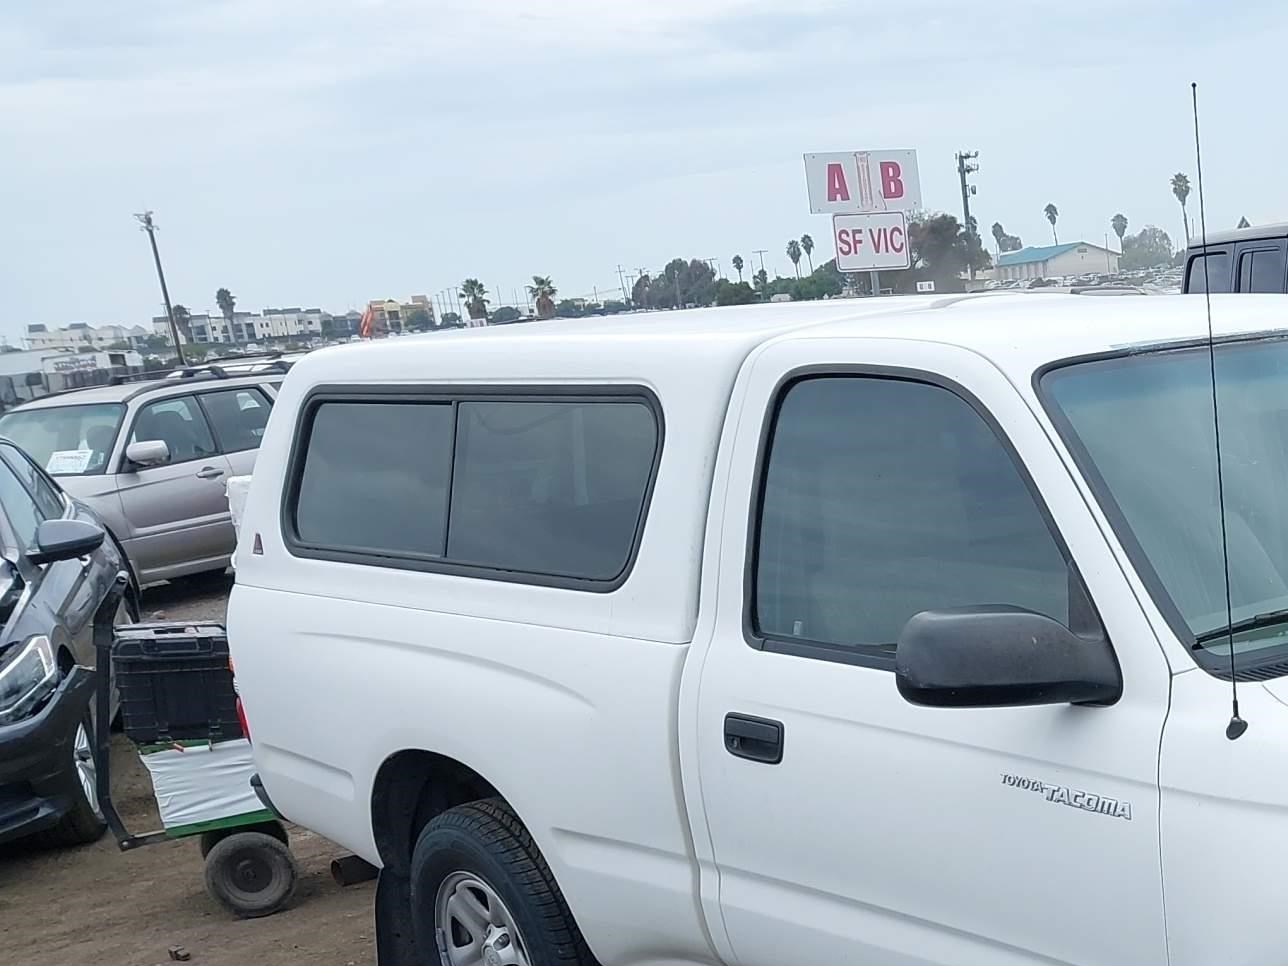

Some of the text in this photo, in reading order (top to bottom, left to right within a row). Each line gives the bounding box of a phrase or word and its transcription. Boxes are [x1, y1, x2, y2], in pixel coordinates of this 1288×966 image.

[827, 161, 904, 201] A B
[838, 226, 904, 256] SF VIC
[1000, 773, 1132, 821] TOYOTA TACOMA
